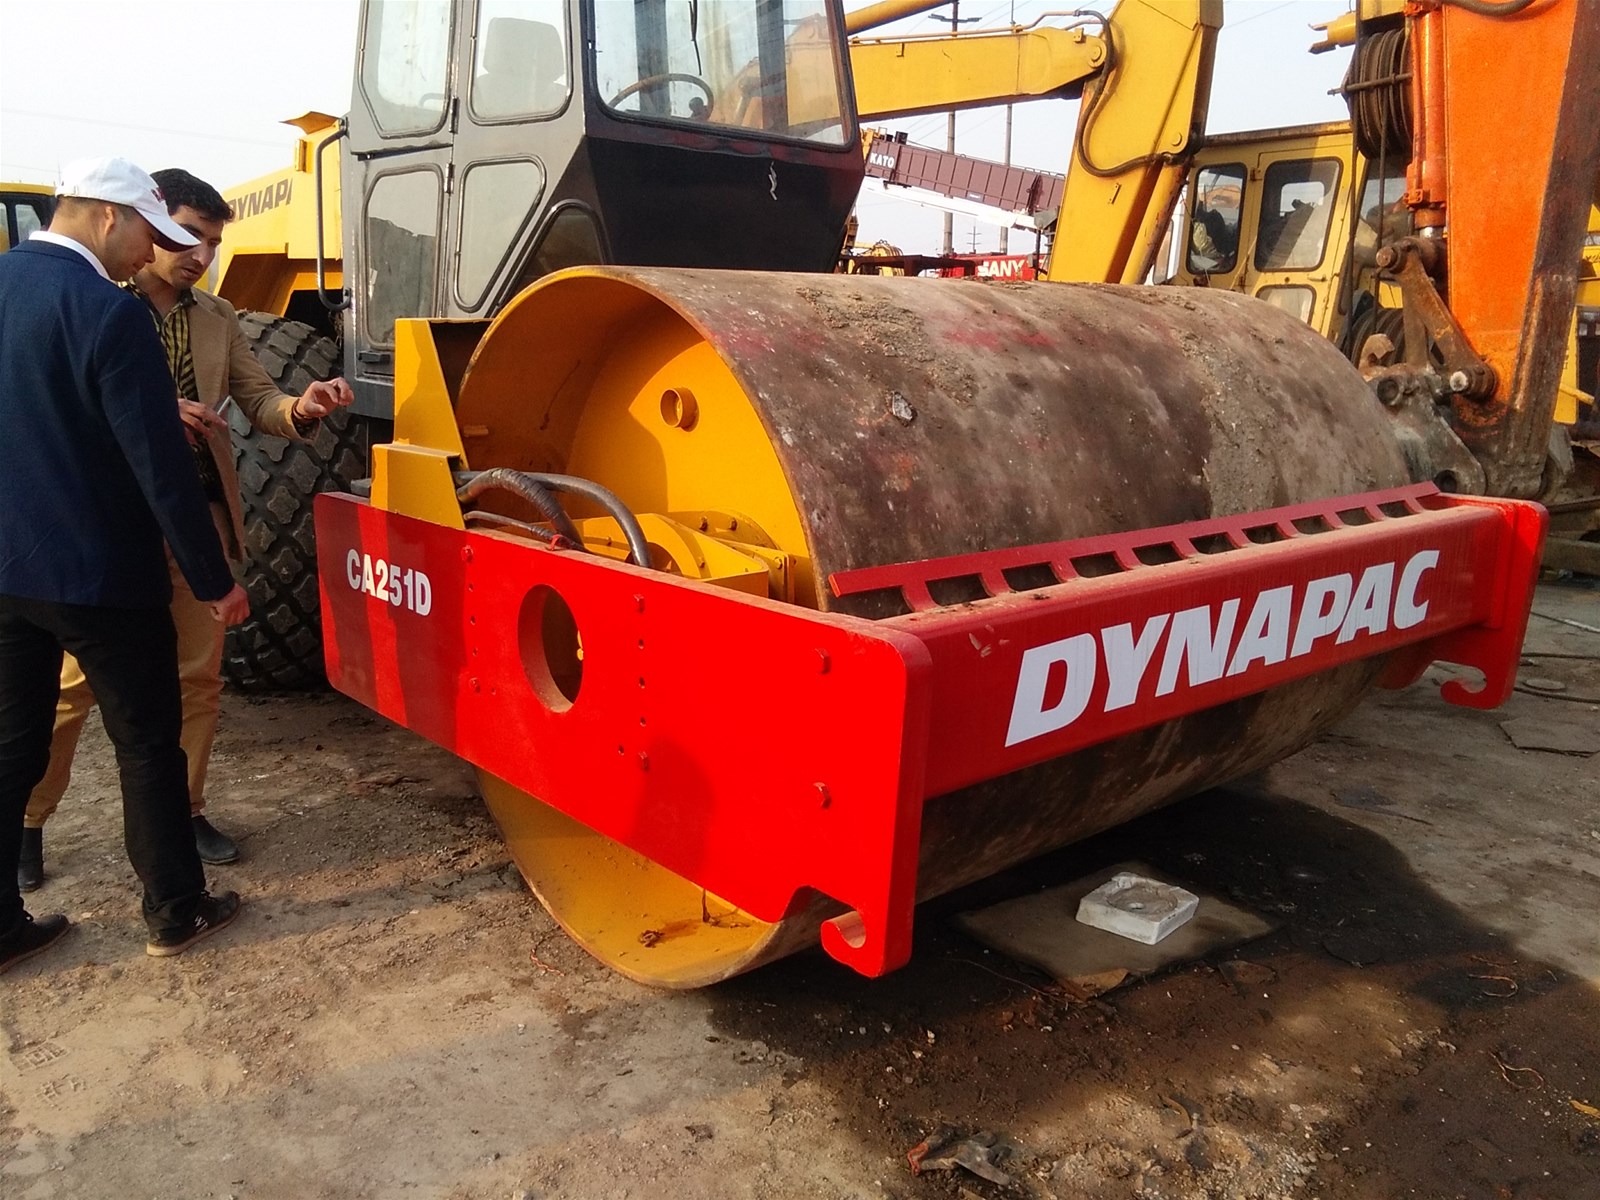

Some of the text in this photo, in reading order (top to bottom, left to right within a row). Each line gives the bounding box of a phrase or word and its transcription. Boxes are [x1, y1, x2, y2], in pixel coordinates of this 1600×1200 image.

[870, 152, 895, 169] KATO
[977, 259, 1025, 277] SANY
[347, 548, 432, 616] CA251D
[1004, 550, 1440, 748] DYNAPAC
